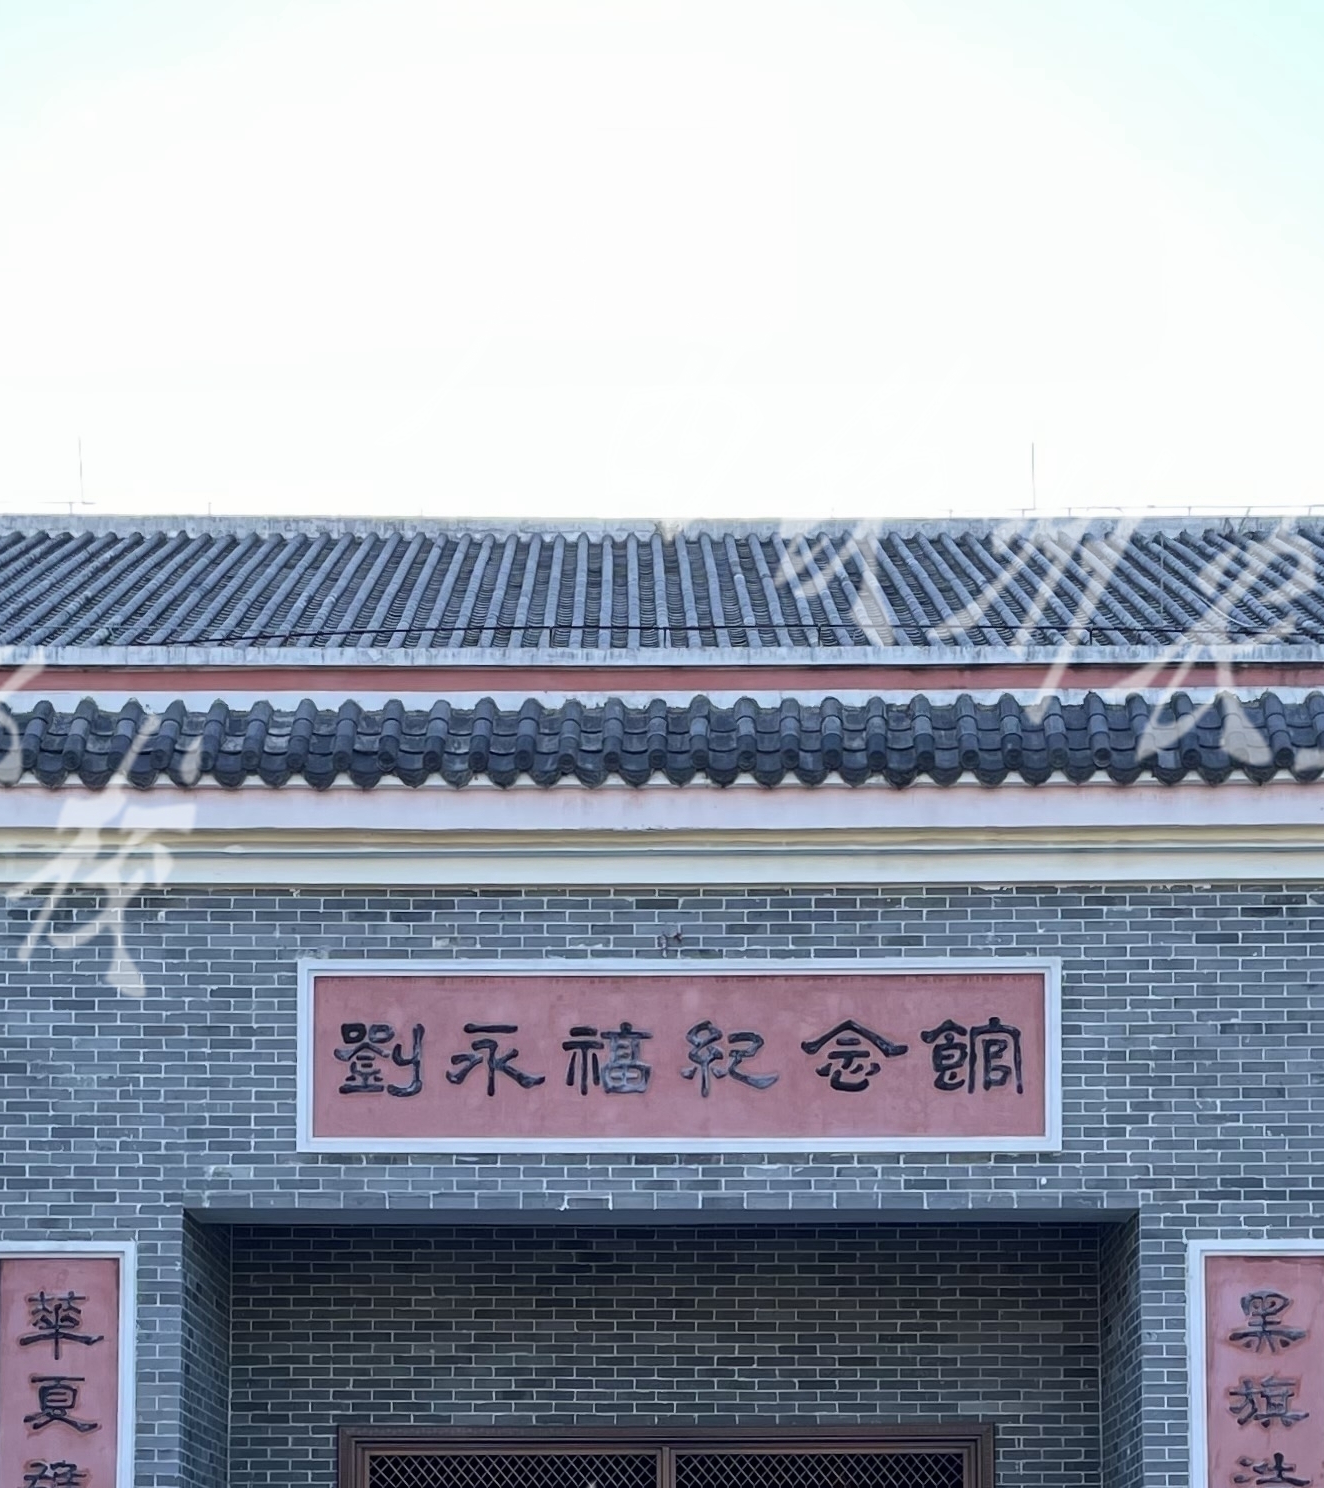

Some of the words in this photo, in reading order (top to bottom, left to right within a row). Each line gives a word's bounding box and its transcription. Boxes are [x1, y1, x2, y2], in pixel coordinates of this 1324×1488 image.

[333, 1017, 1025, 1098] 劉永福紀念館
